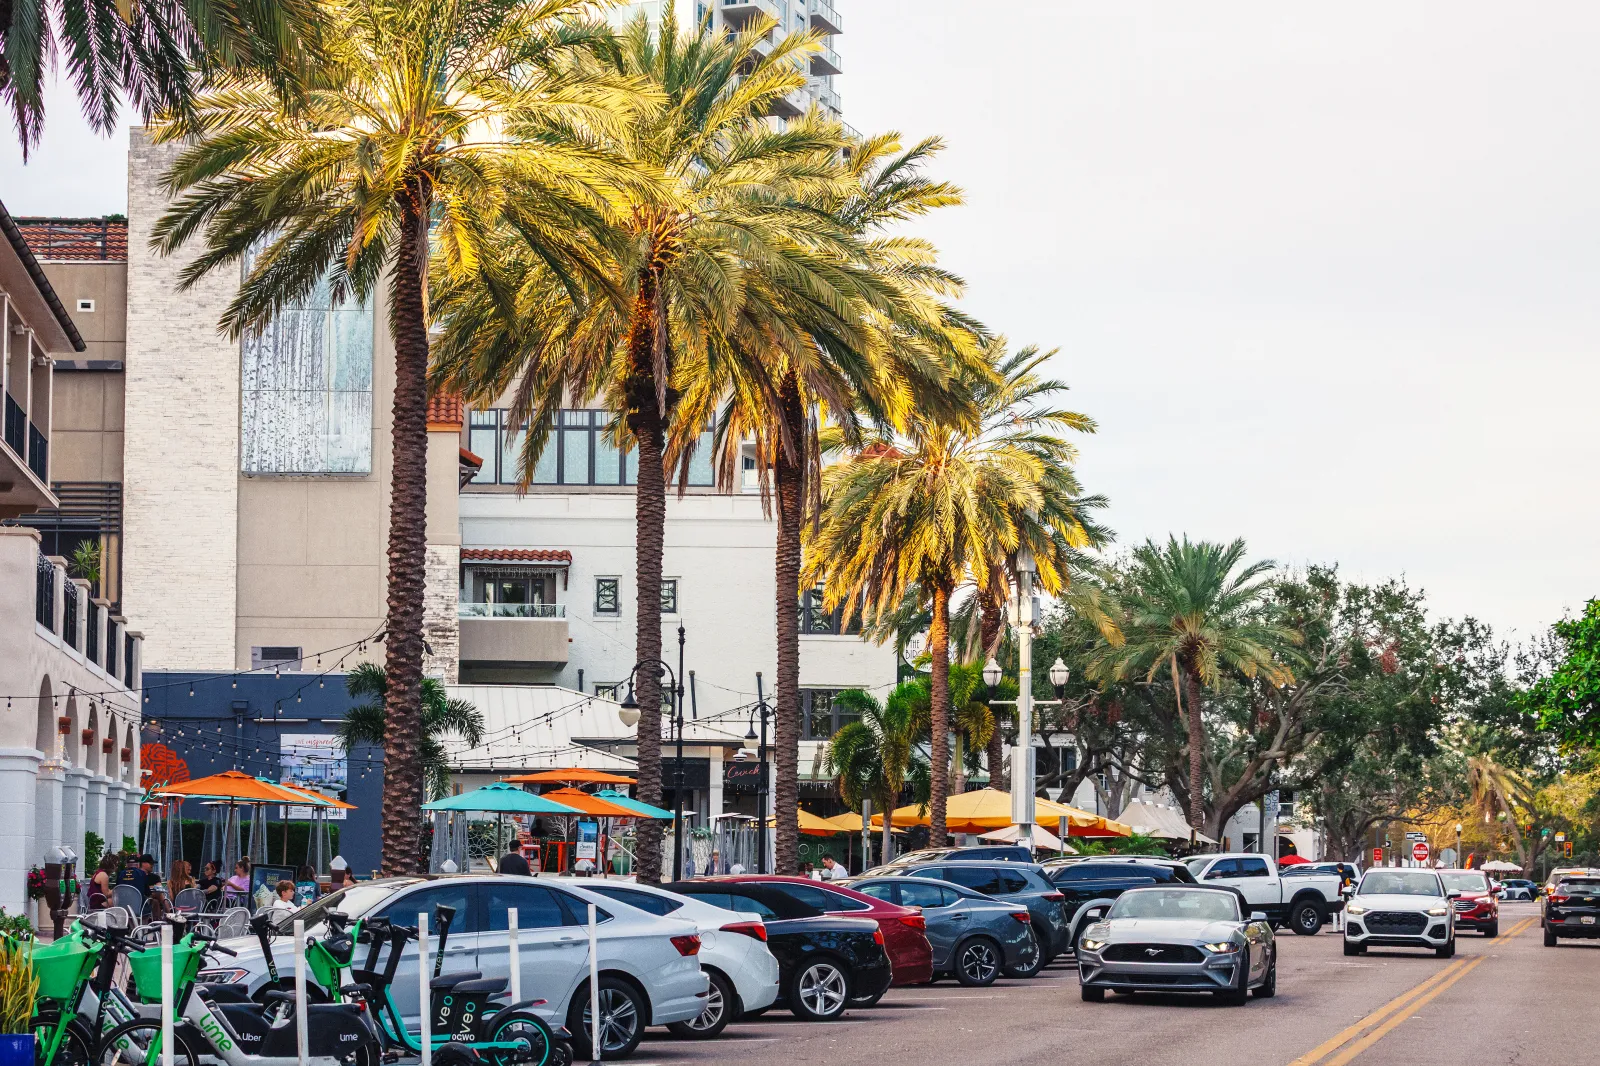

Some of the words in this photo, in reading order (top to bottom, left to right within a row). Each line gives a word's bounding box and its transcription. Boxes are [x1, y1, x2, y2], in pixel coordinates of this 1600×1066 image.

[267, 960, 280, 983] veo
[437, 995, 454, 1026] veo
[460, 1001, 476, 1034] veo
[200, 1012, 232, 1052] Lime
[242, 1032, 262, 1042] Uber
